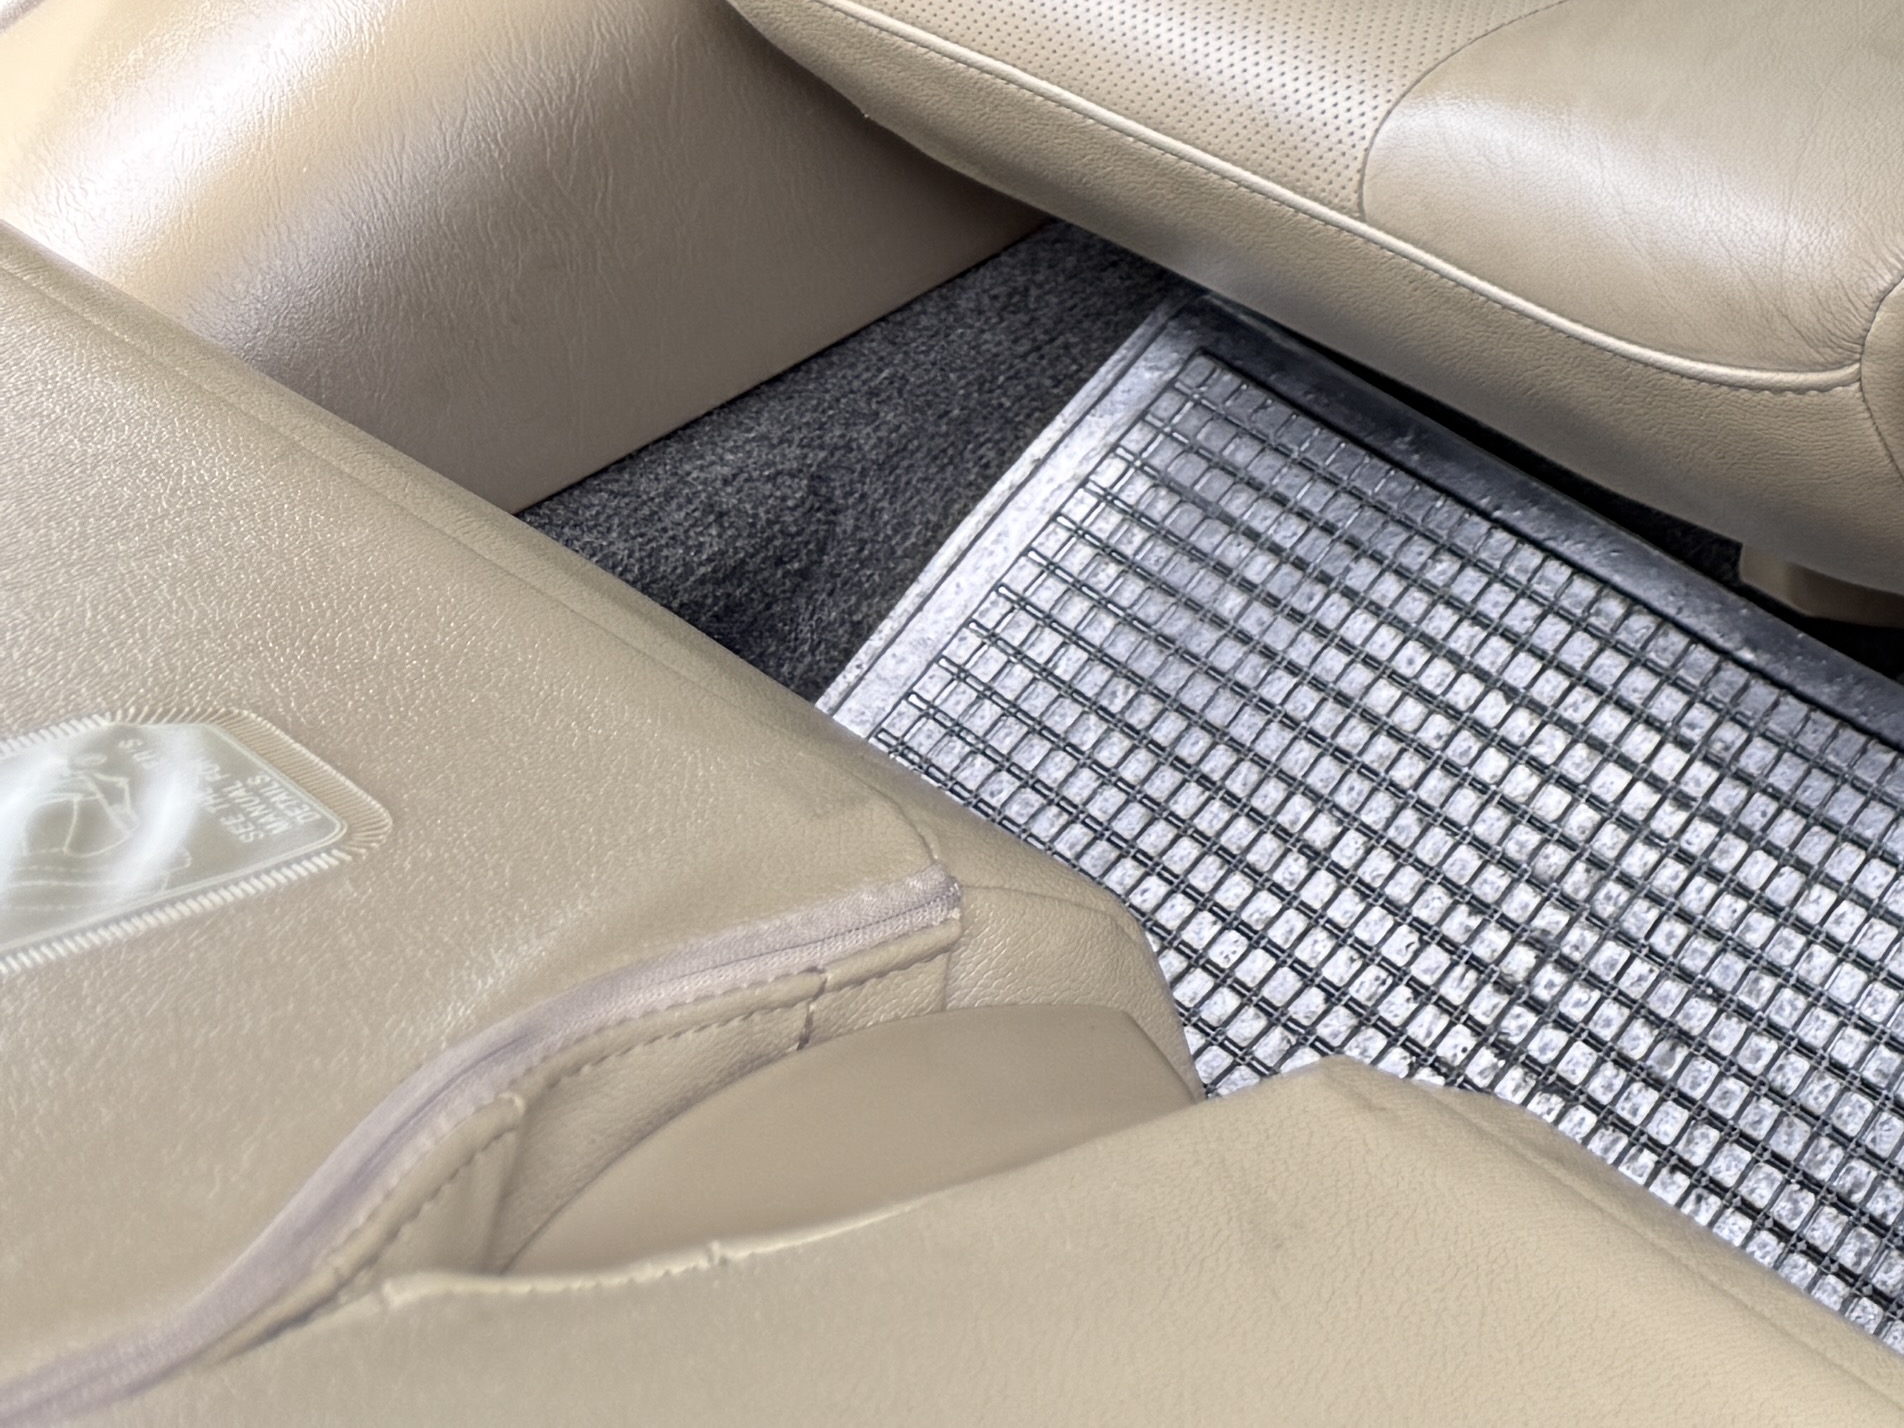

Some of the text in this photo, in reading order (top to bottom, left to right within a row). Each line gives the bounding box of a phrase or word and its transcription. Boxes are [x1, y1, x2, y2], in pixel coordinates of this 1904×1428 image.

[222, 780, 293, 834] MANUAL
[246, 770, 321, 825] DETAILS
[219, 814, 265, 843] SEE
